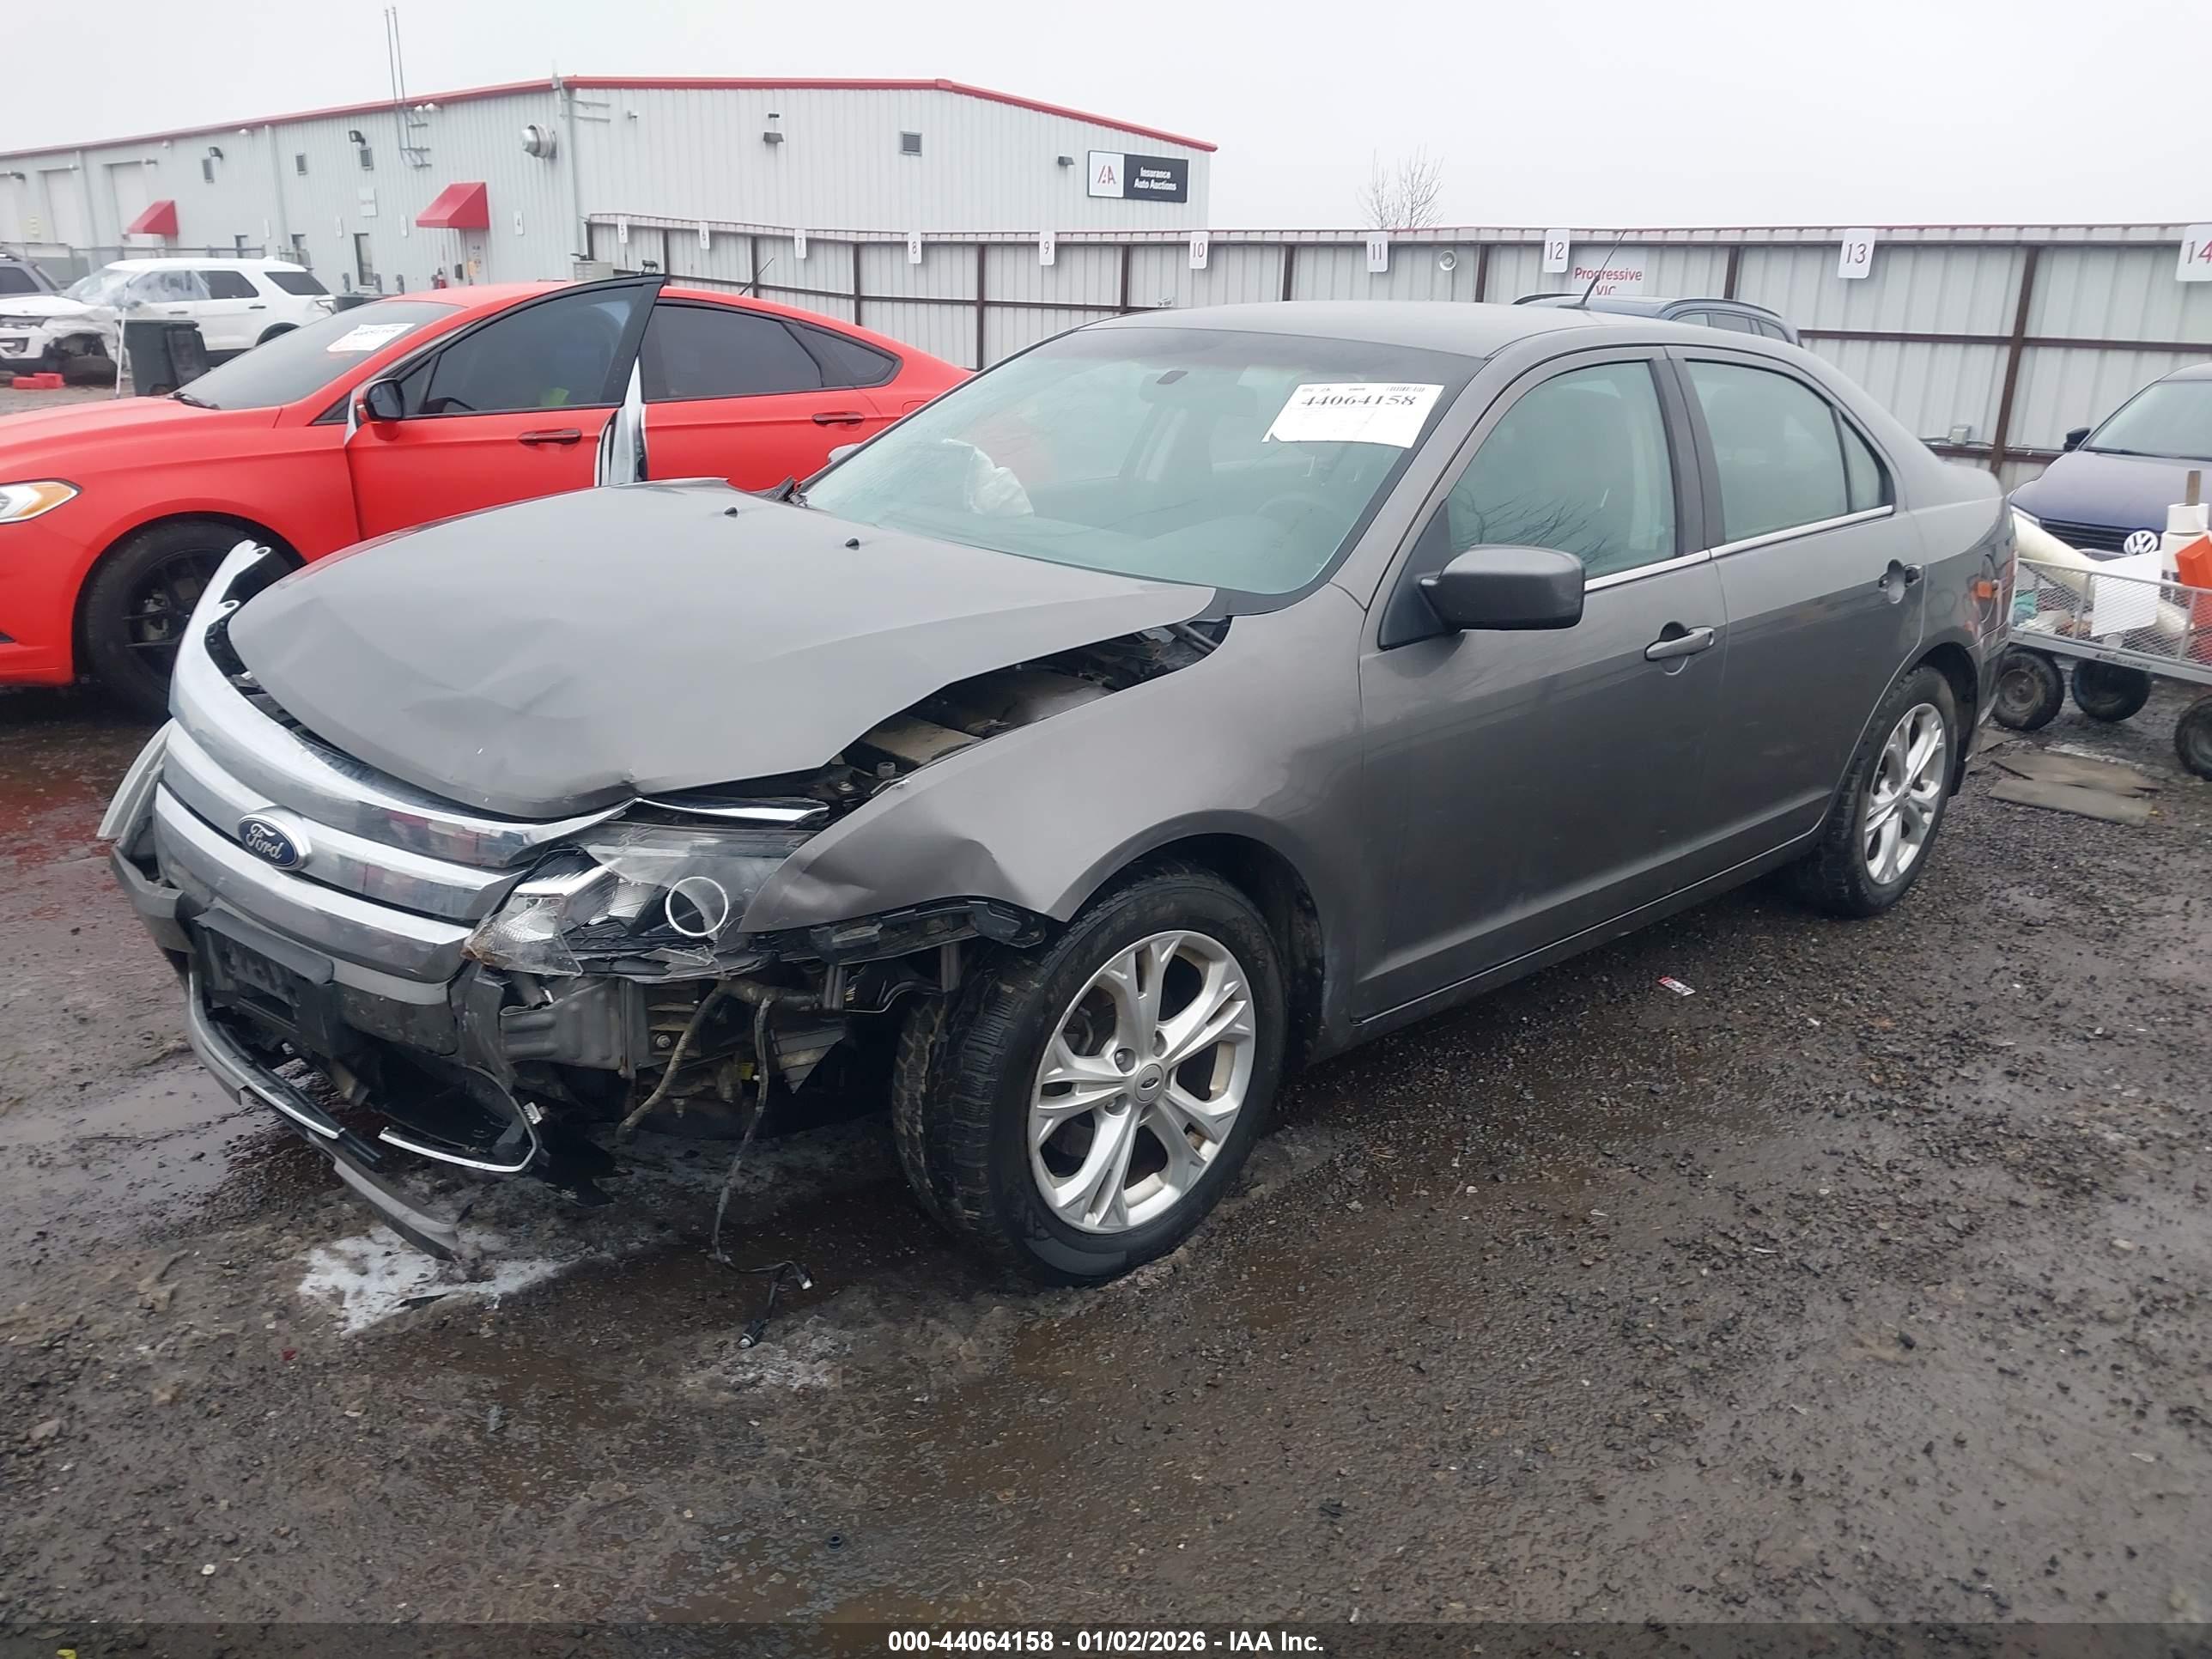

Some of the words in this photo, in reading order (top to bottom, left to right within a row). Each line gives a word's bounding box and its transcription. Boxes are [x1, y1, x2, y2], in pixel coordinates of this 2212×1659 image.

[1139, 167, 1171, 179] Insurance
[1133, 178, 1150, 189] Auto
[1150, 179, 1177, 191] Auctions
[798, 237, 803, 250] 7
[912, 241, 917, 254] 8
[1043, 240, 1049, 254] 9
[1192, 240, 1204, 258] 10
[1370, 242, 1382, 261] 11
[1548, 241, 1565, 260] 12
[1846, 243, 1867, 264] 13
[2185, 240, 2212, 264] 14
[1301, 395, 1417, 406] 44064158
[246, 823, 285, 860] Ford
